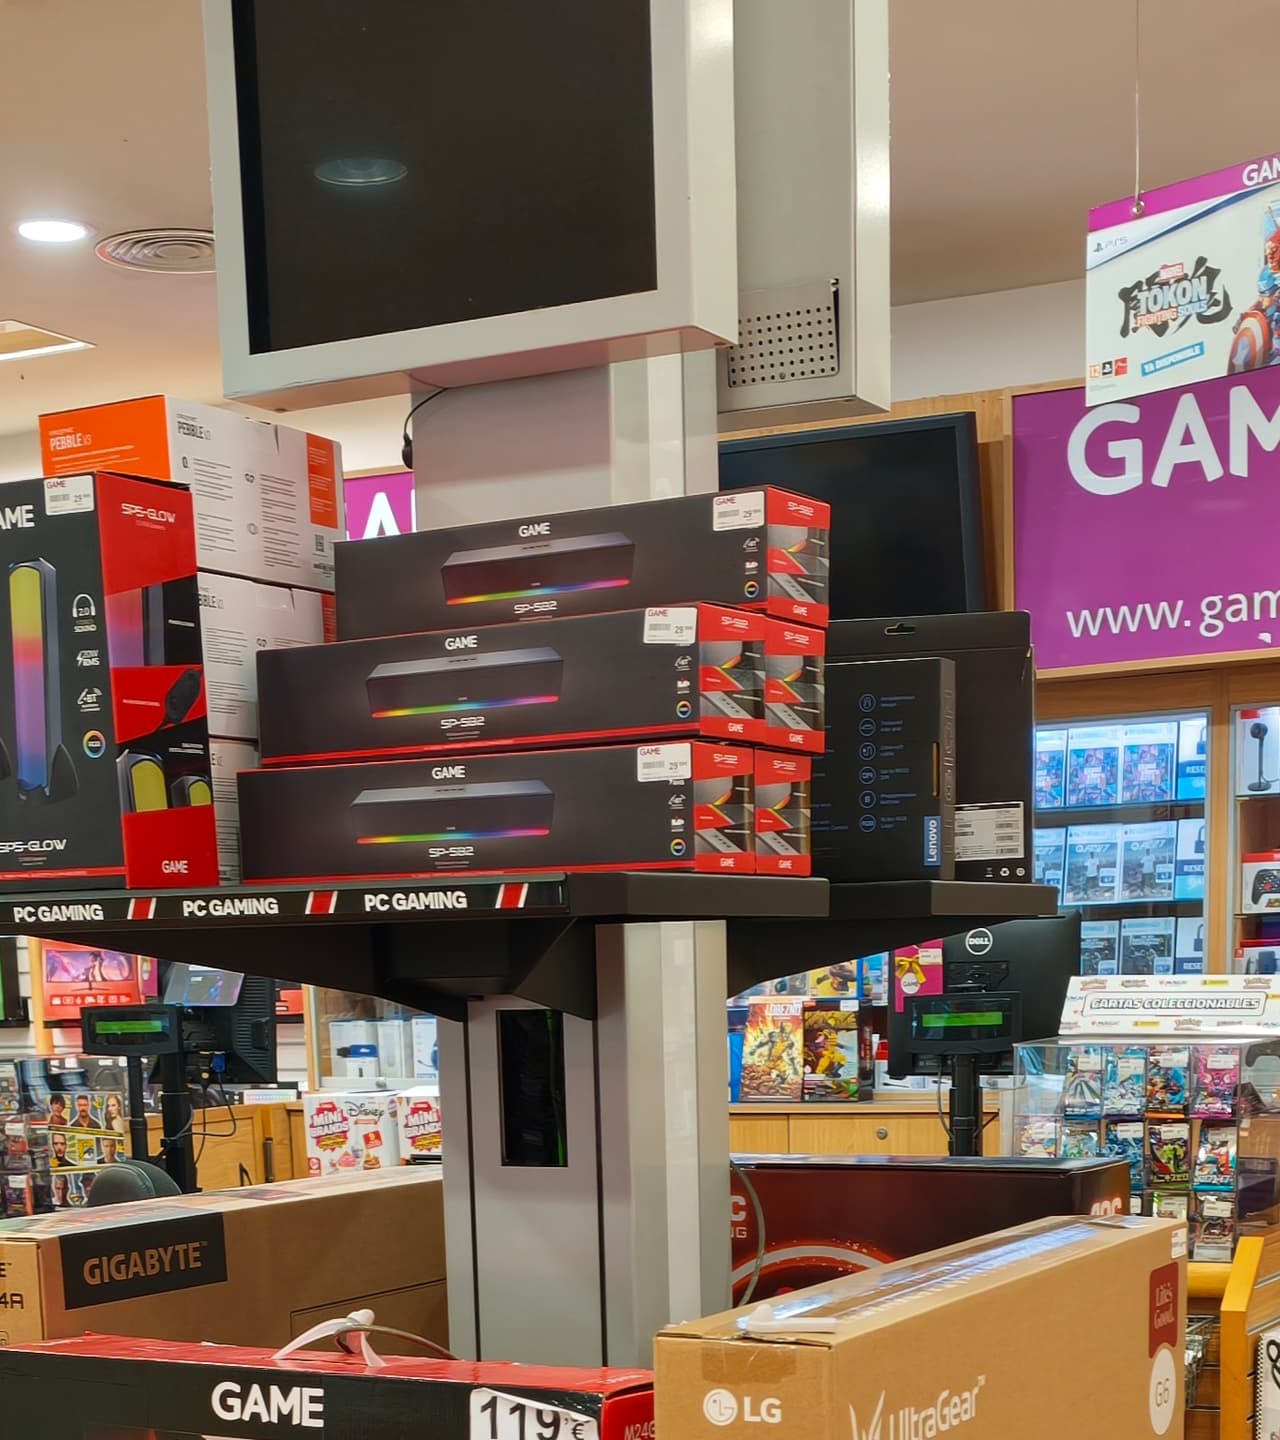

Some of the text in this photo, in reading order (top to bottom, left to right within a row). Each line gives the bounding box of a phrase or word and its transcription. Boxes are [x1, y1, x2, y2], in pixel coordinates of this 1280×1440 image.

[1136, 301, 1208, 327] FIGHTING SOULS
[928, 820, 937, 862] Lenovo
[13, 904, 103, 922] PC GAMING
[183, 897, 279, 916] PC GAMING
[364, 891, 468, 911] PC GAMING
[968, 937, 990, 946] DELL
[1090, 997, 1260, 1009] CARTAS COLECCIONABLES
[83, 1241, 208, 1285] GIGABYTE
[211, 1381, 325, 1429] GAME
[1154, 1376, 1171, 1410] G6
[744, 1397, 782, 1424] LG
